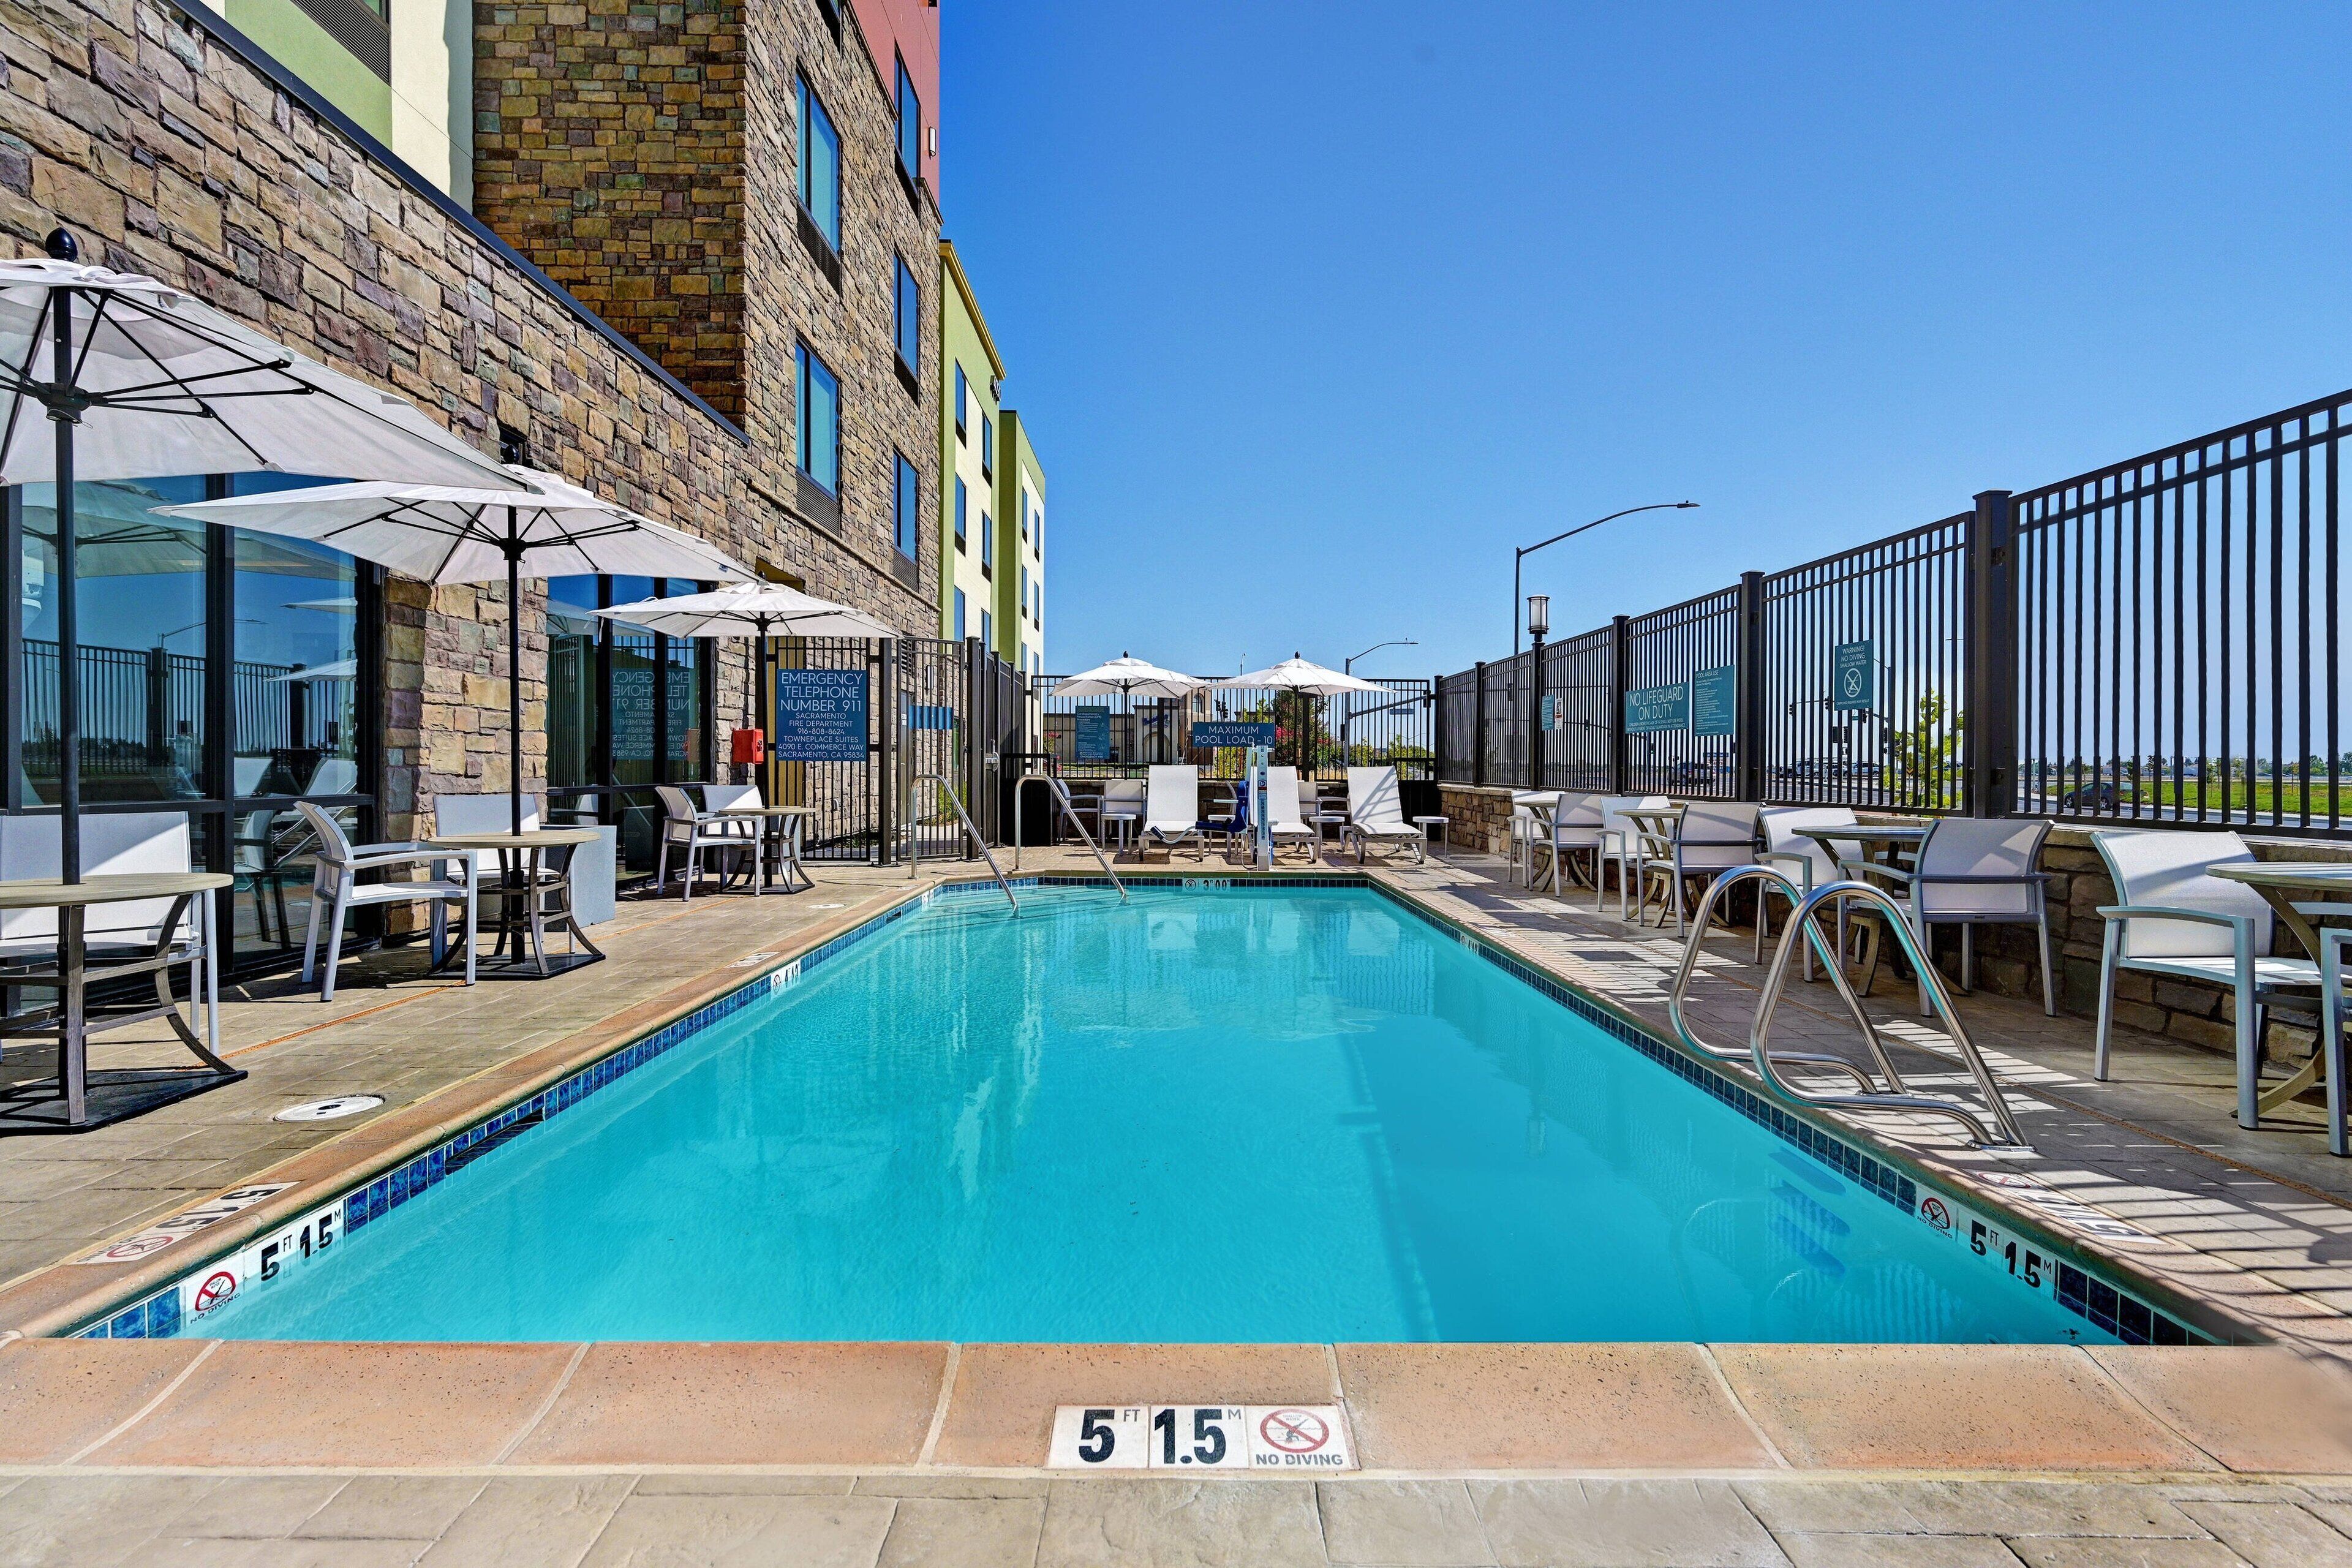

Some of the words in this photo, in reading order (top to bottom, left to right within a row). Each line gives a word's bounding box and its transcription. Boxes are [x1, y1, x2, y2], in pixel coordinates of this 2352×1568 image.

[1842, 646, 1865, 654] WARNING!
[782, 673, 862, 684] EMERGENCY
[784, 686, 859, 698] TELEPHONE
[1629, 693, 1641, 706] NO
[1643, 686, 1684, 705] LIFEGUARD
[781, 699, 835, 711] NUMBER
[842, 700, 861, 711] 911
[1638, 706, 1649, 720] ON
[1653, 703, 1673, 718] DUTY
[220, 1188, 284, 1200] 5
[1929, 1223, 1953, 1239] DIVING
[261, 1242, 280, 1281] 5
[284, 1235, 292, 1252] FT
[300, 1213, 333, 1259] 1.5
[334, 1208, 341, 1222] M
[1970, 1219, 1986, 1256] 5
[1990, 1229, 1999, 1246] FT
[2005, 1241, 2041, 1287] 1.5
[2043, 1259, 2052, 1274] M
[190, 1313, 205, 1324] NO
[208, 1292, 241, 1314] DIVING
[1079, 1409, 1115, 1463] 5
[1123, 1409, 1140, 1422] FT
[1155, 1409, 1226, 1464] 1.5
[1228, 1409, 1241, 1420] M
[1256, 1454, 1280, 1465] NO
[1285, 1454, 1343, 1465] DIVING
